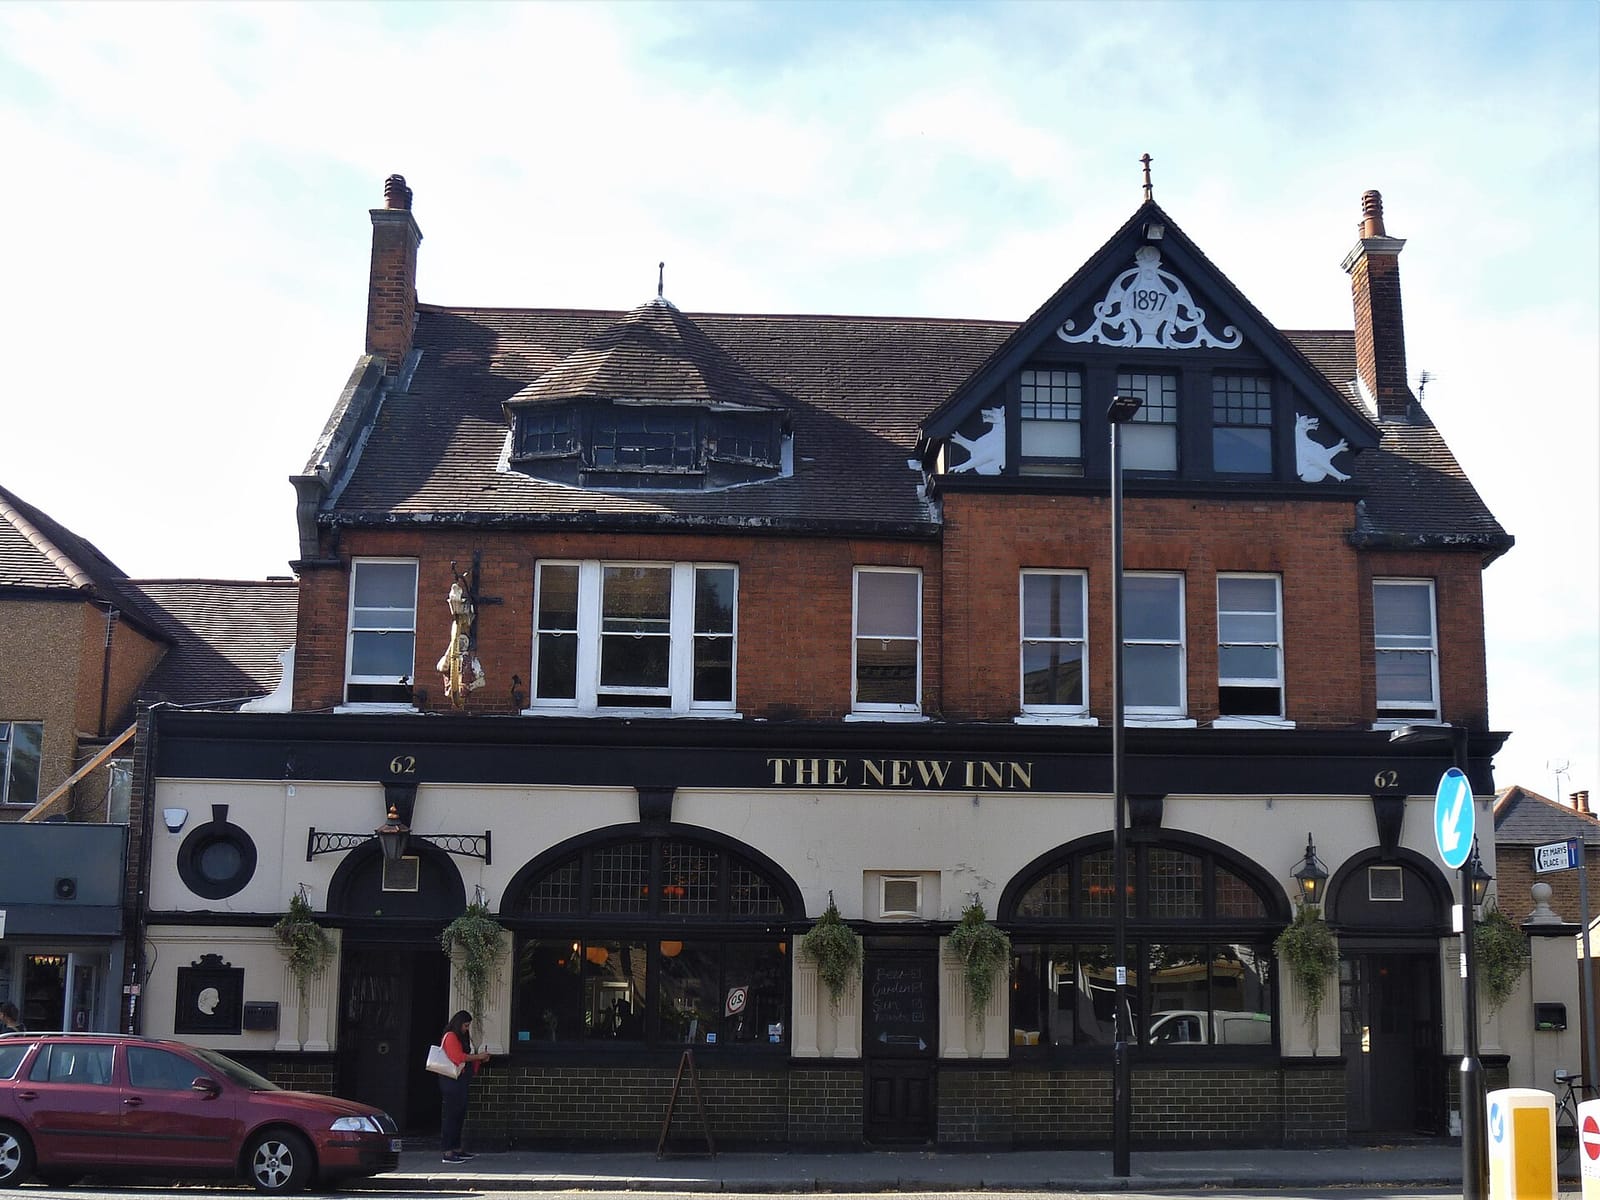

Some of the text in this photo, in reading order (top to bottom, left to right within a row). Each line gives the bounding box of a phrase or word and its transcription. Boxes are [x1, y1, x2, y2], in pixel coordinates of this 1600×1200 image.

[1132, 289, 1168, 312] 1897
[390, 755, 416, 774] 62
[766, 757, 1034, 789] THE NEW INN
[1374, 769, 1399, 789] 62
[1543, 857, 1560, 868] PLACE
